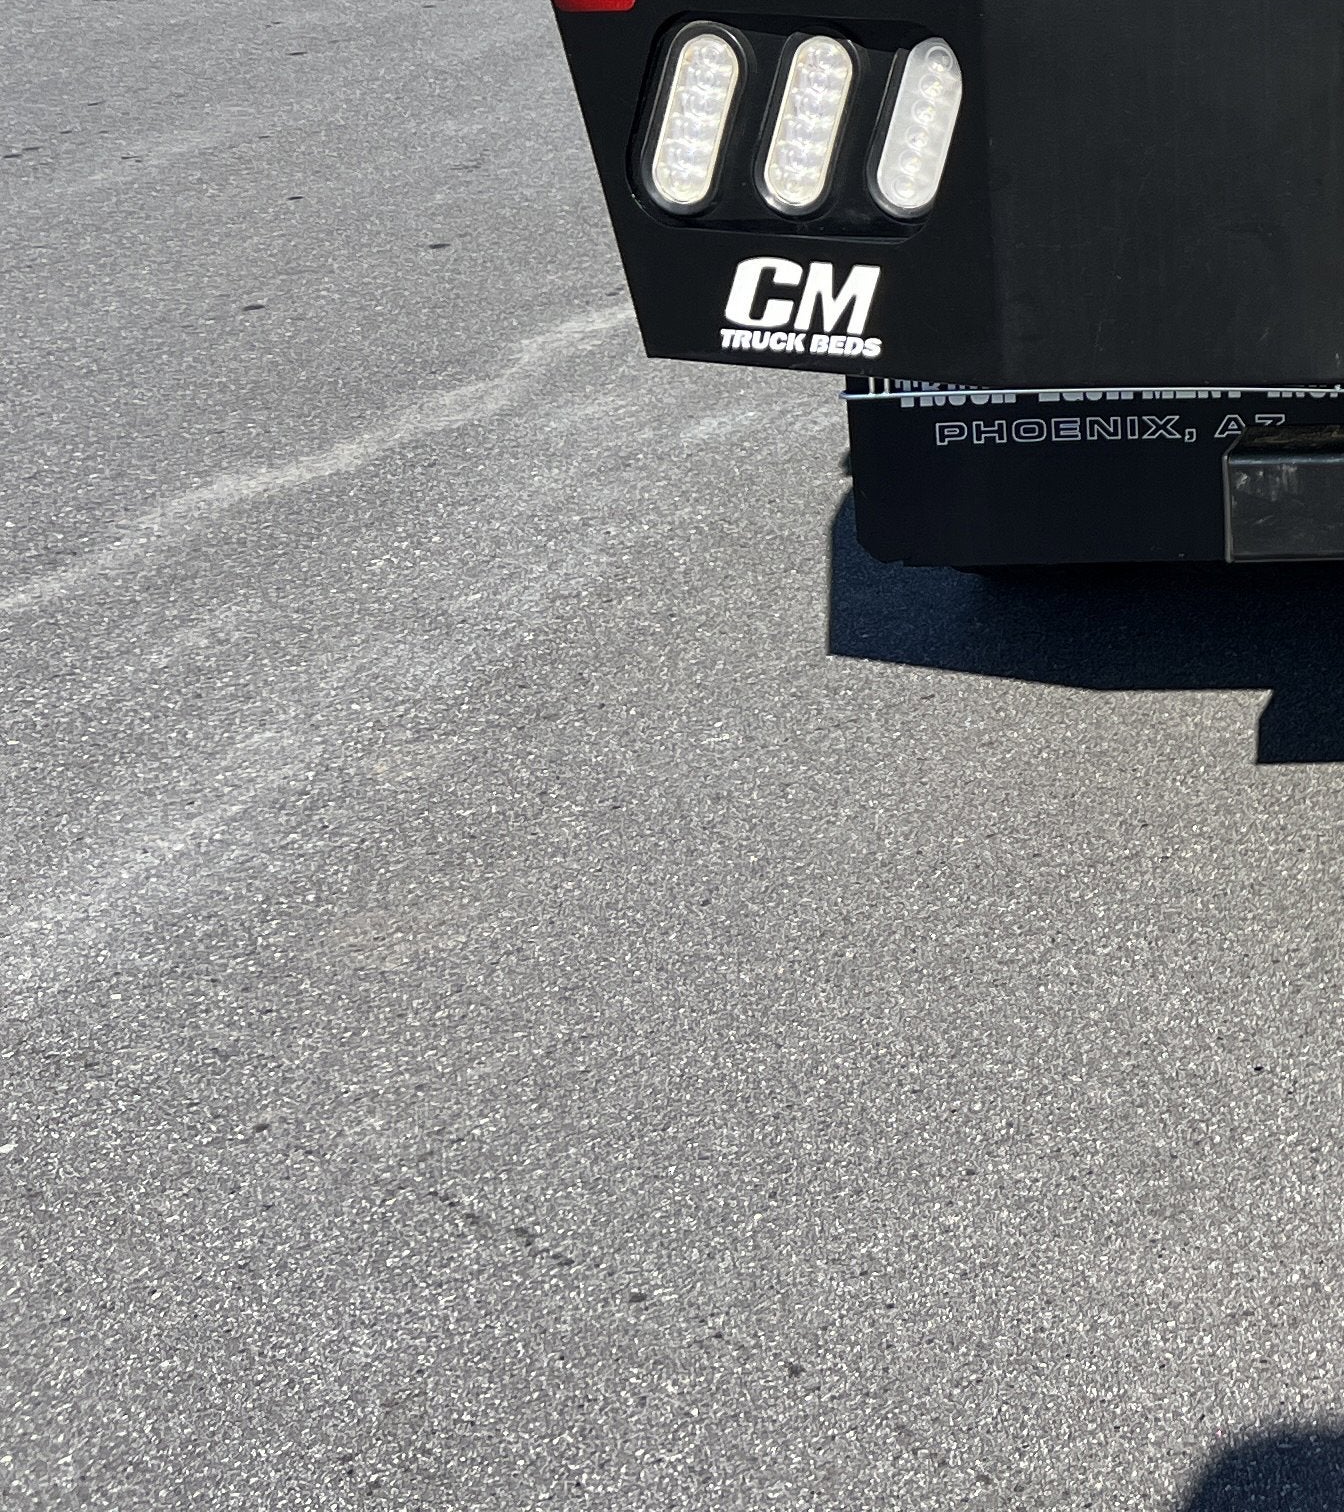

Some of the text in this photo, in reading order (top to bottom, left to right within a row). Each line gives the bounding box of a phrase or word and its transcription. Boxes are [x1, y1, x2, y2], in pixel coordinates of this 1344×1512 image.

[725, 256, 881, 336] CM
[720, 328, 883, 357] TRUCK BEDS
[936, 415, 1197, 445] PHOENIX,
